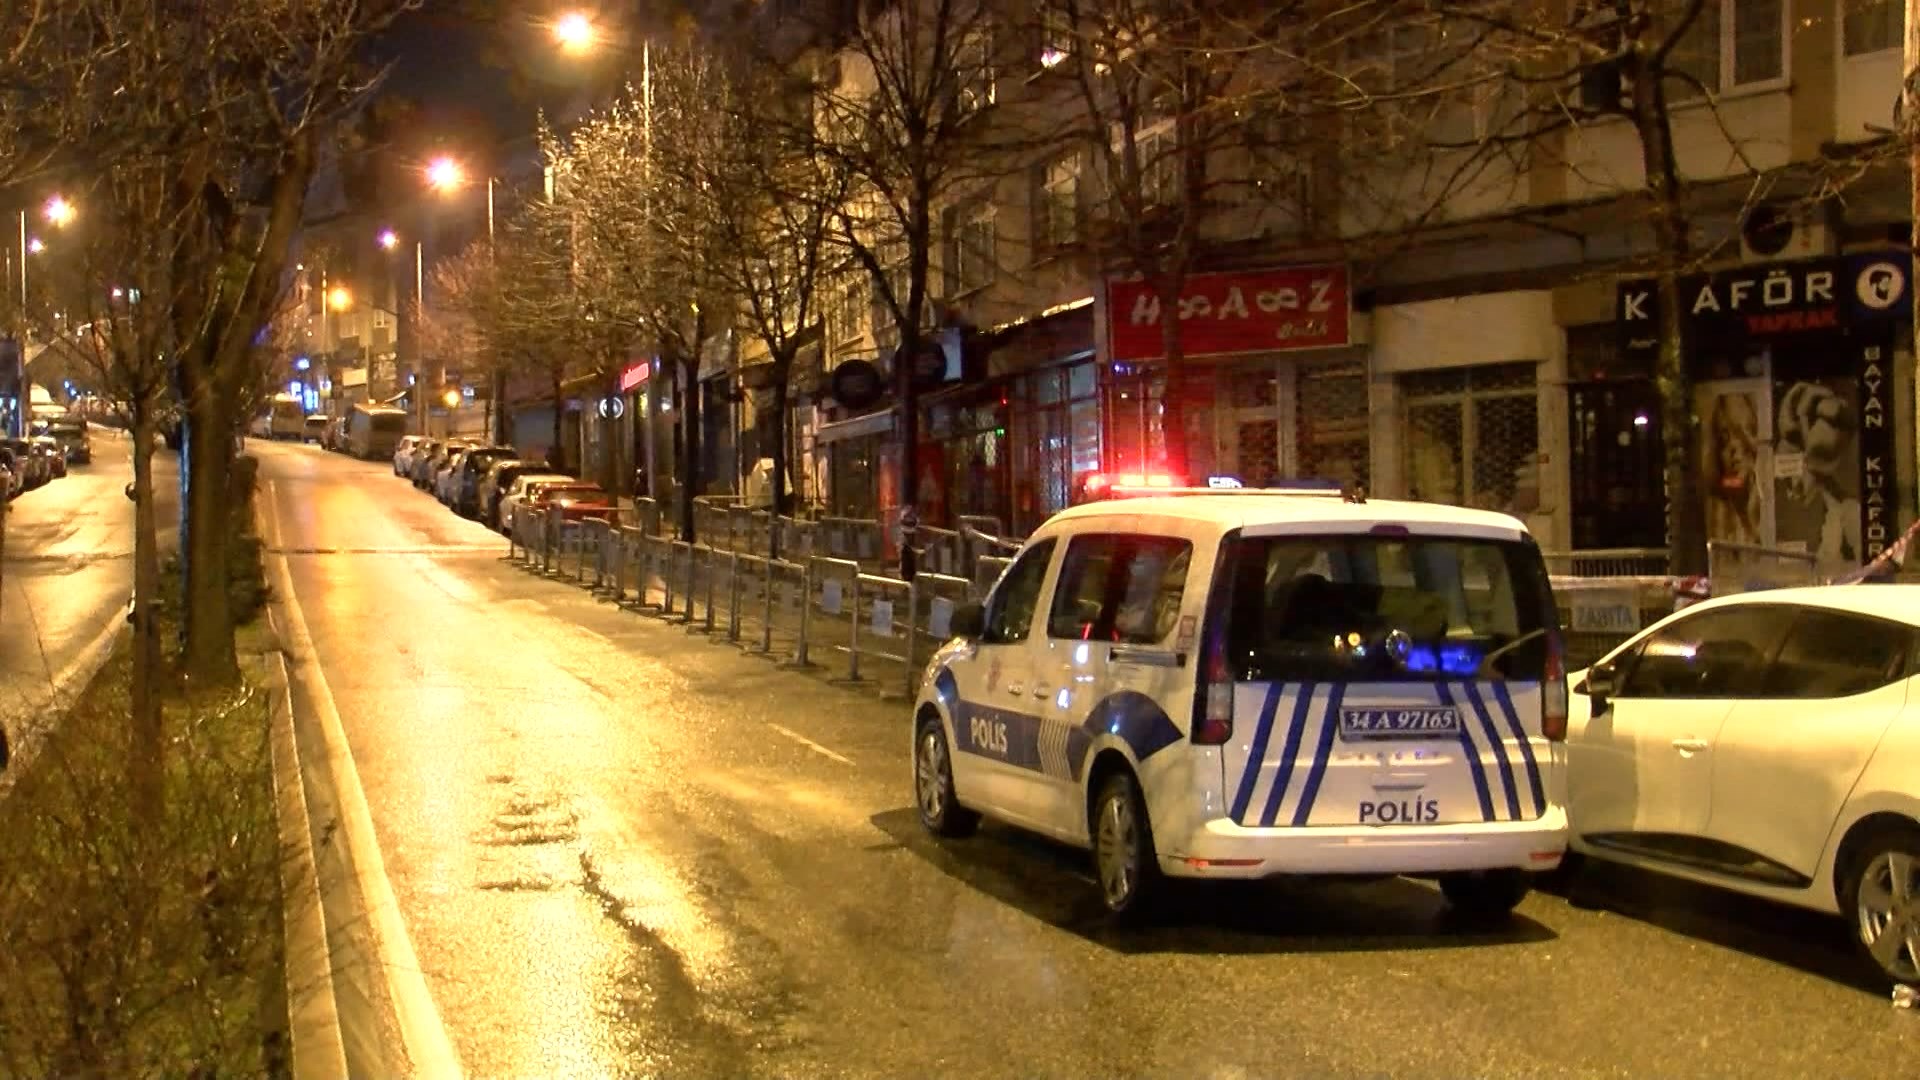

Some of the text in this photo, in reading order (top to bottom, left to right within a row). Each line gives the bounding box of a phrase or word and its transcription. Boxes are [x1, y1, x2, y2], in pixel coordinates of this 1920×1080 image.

[1623, 269, 1834, 321] KAFÖR
[1863, 345, 1883, 429] BAYAN
[970, 713, 1008, 752] POLİS
[1349, 710, 1453, 730] 34 A 97165
[1358, 794, 1440, 823] POLİS
